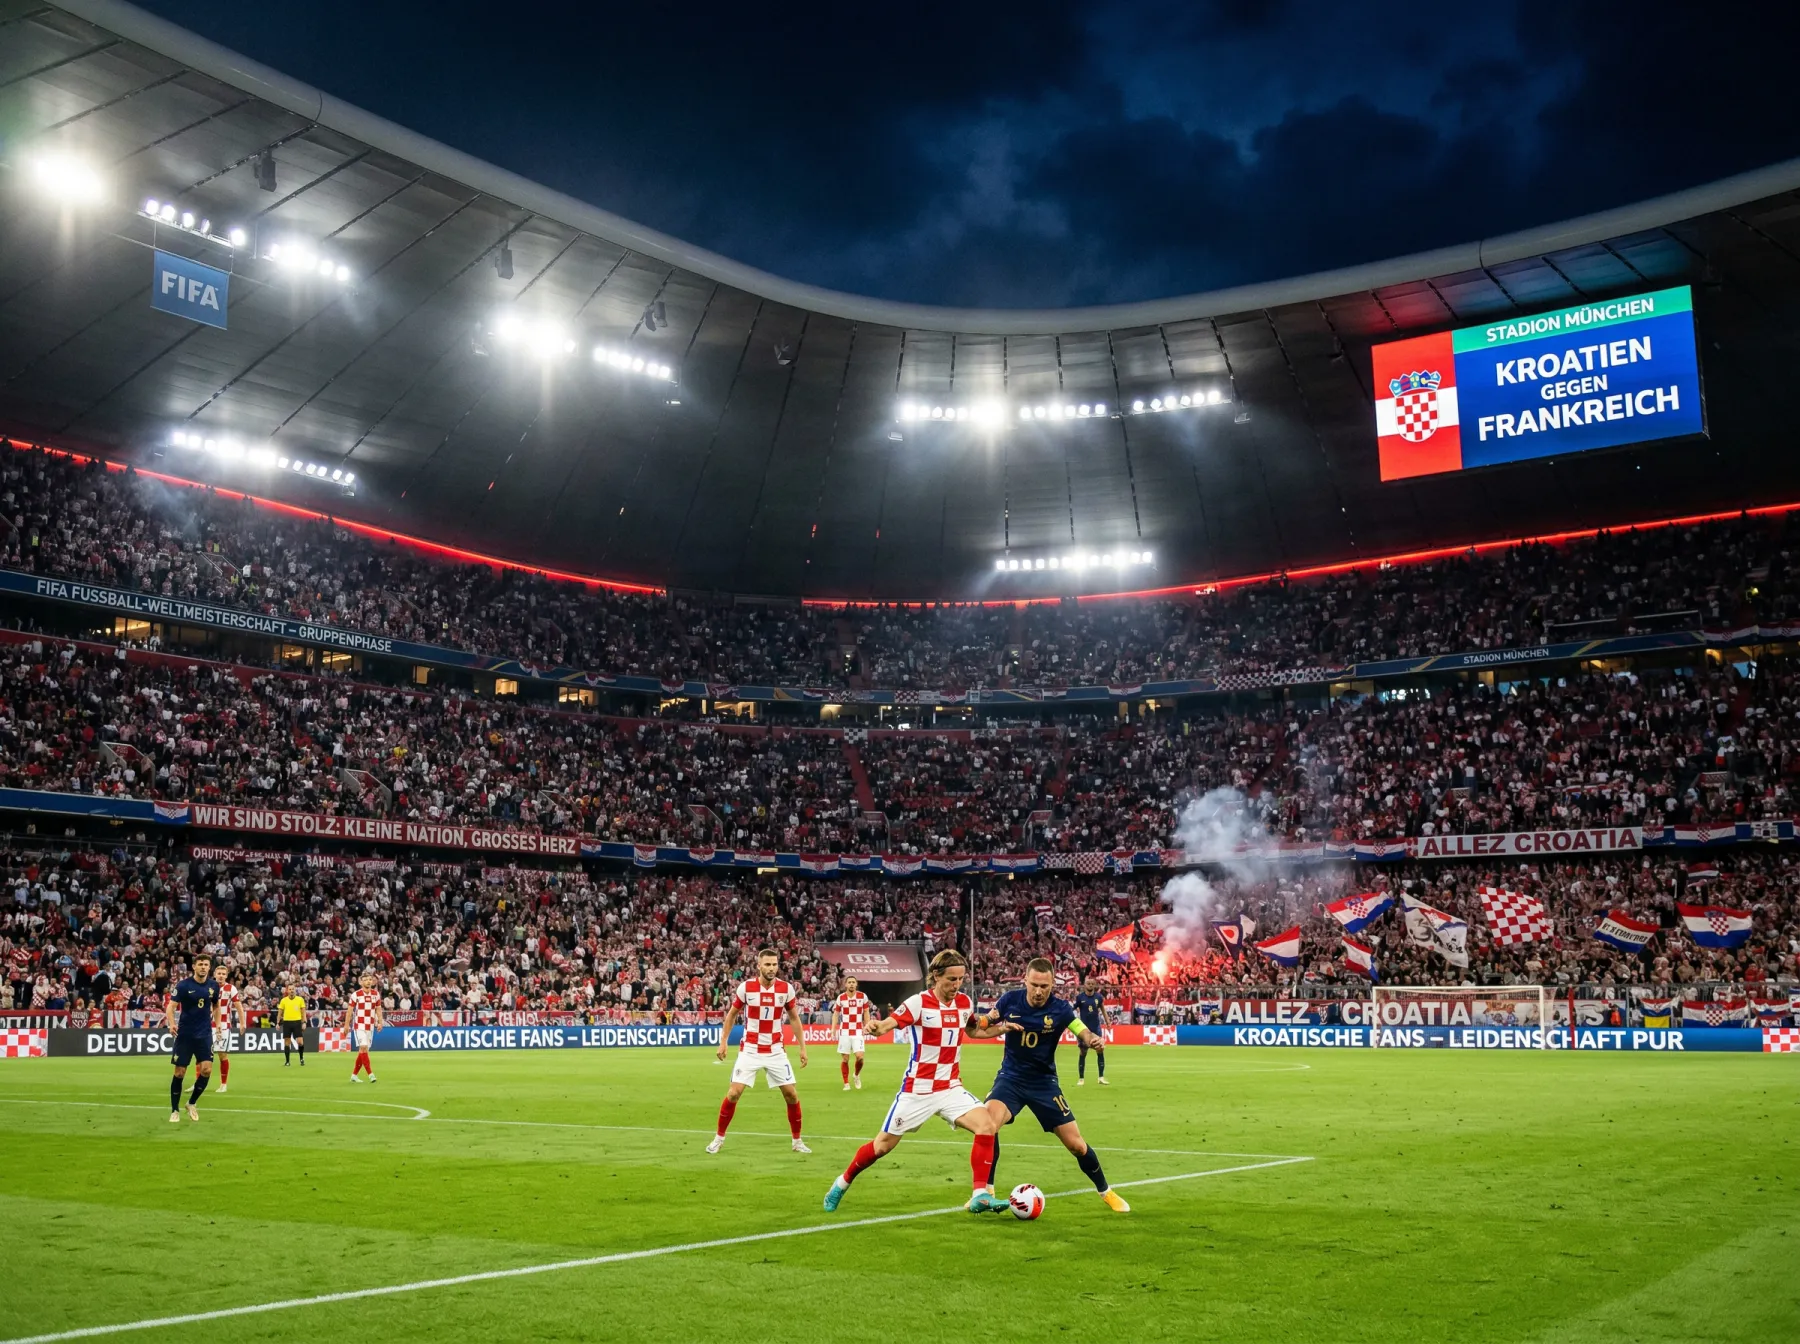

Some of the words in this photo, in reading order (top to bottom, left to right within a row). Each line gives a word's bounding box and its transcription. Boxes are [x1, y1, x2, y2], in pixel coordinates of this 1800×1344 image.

[162, 270, 220, 311] FIFA
[1486, 317, 1561, 342] STADION
[1565, 297, 1654, 328] MÜNCHEN
[1495, 336, 1652, 386] KROATIEN
[1540, 374, 1609, 400] GEGEN
[1477, 385, 1680, 441] FRANKREICH
[36, 579, 68, 598] FIFA
[71, 585, 287, 635] FUSSBALL-WELTMEISTERSCHAFT
[299, 625, 392, 652] GRUPPENPHASE
[1463, 653, 1501, 664] STADION
[1503, 648, 1549, 660] MÜNCHEN
[194, 805, 230, 826] WIR
[234, 809, 277, 830] SIND
[281, 813, 341, 836] STOLZ:
[344, 819, 403, 841] KLEINE
[406, 825, 468, 849] NATION,
[471, 831, 536, 851] GROSSES
[539, 836, 576, 854] HERZ
[1422, 835, 1506, 857] ALLEZ
[1513, 829, 1638, 853] CROATIA
[764, 1007, 770, 1019] 7
[1225, 1001, 1310, 1024] ALLEZ
[1342, 1001, 1472, 1026] CROATIA
[403, 1029, 517, 1049] KROATISCHE
[520, 1028, 564, 1048] FANS
[582, 1028, 696, 1046] LEIDENSCHAFT
[947, 1029, 954, 1046] 7
[1021, 1031, 1039, 1048] 10
[1234, 1028, 1364, 1046] KROATISCHE
[1369, 1028, 1425, 1047] FANS
[1450, 1029, 1626, 1050] LEIDENSCHAFT
[1633, 1030, 1685, 1050] PUR
[1053, 1095, 1070, 1112] 10
